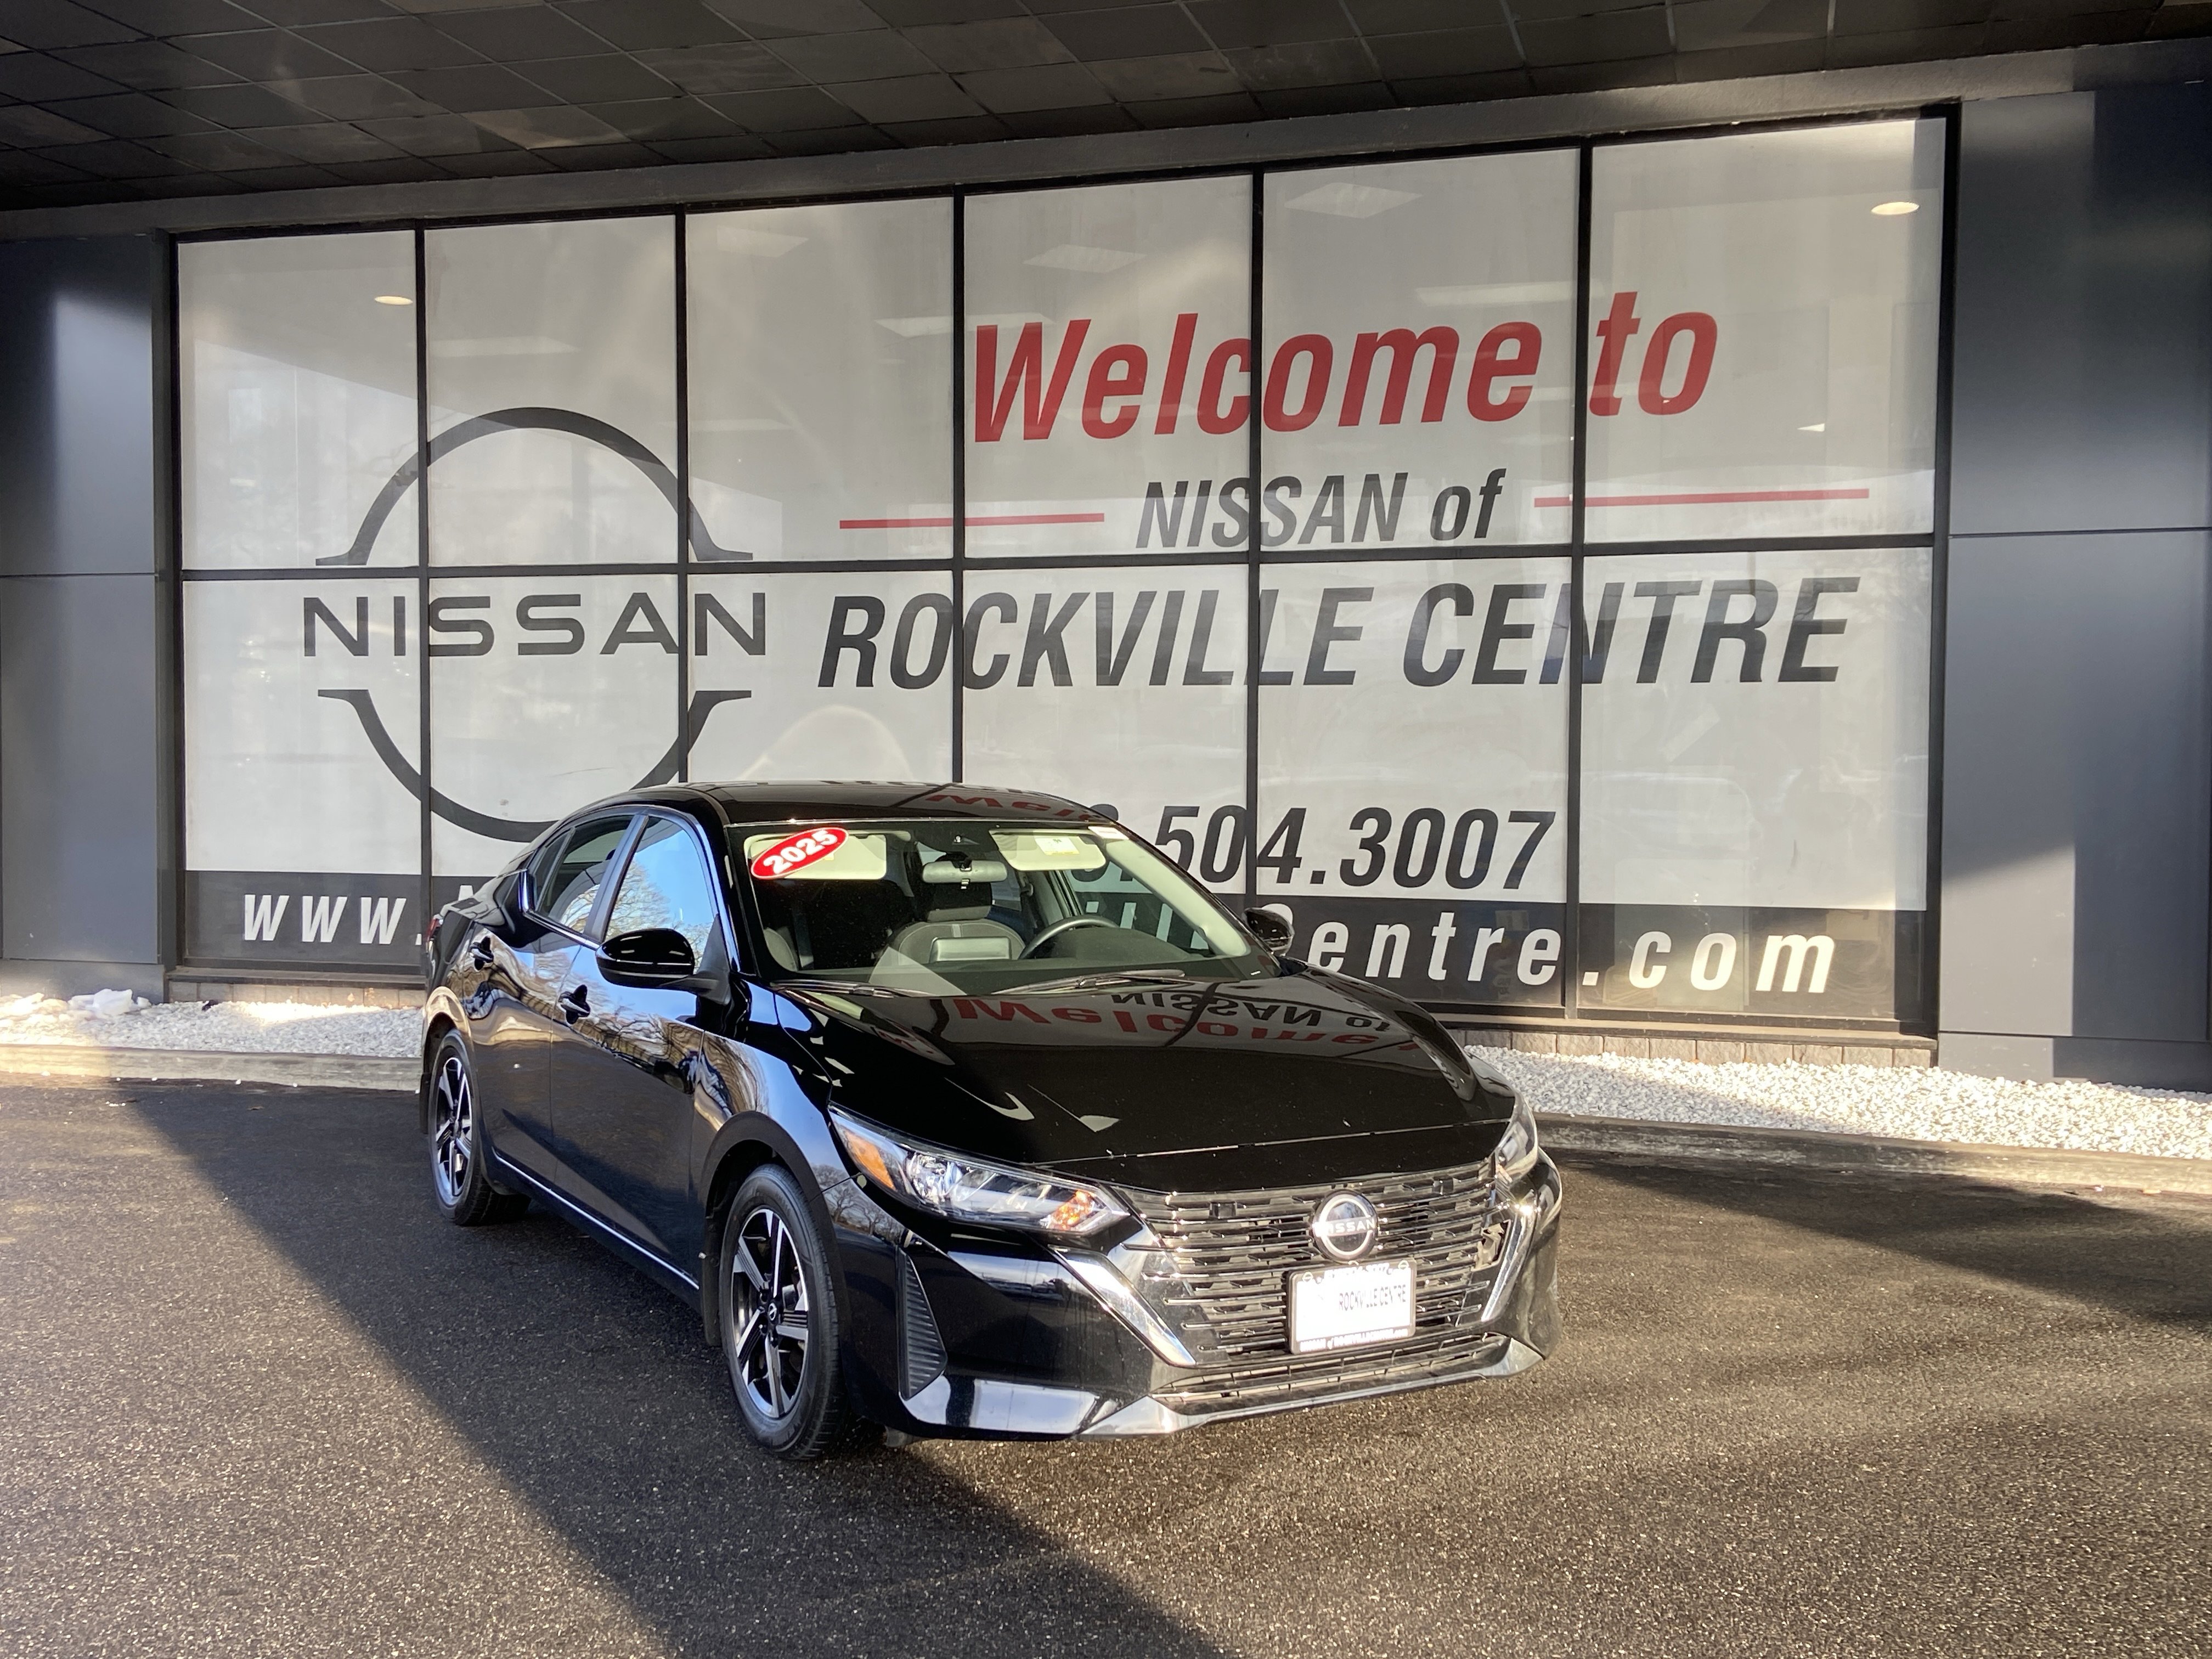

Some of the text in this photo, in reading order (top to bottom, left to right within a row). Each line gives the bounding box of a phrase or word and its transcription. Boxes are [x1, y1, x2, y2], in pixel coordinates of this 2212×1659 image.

[974, 290, 1718, 443] Welcome to
[1135, 468, 1506, 549] NISSAN of
[303, 592, 766, 657] NISSAN
[817, 577, 1860, 690] ROCKVILLE CENTRE
[763, 829, 838, 874] 2025
[1318, 1217, 1376, 1235] ISSAN
